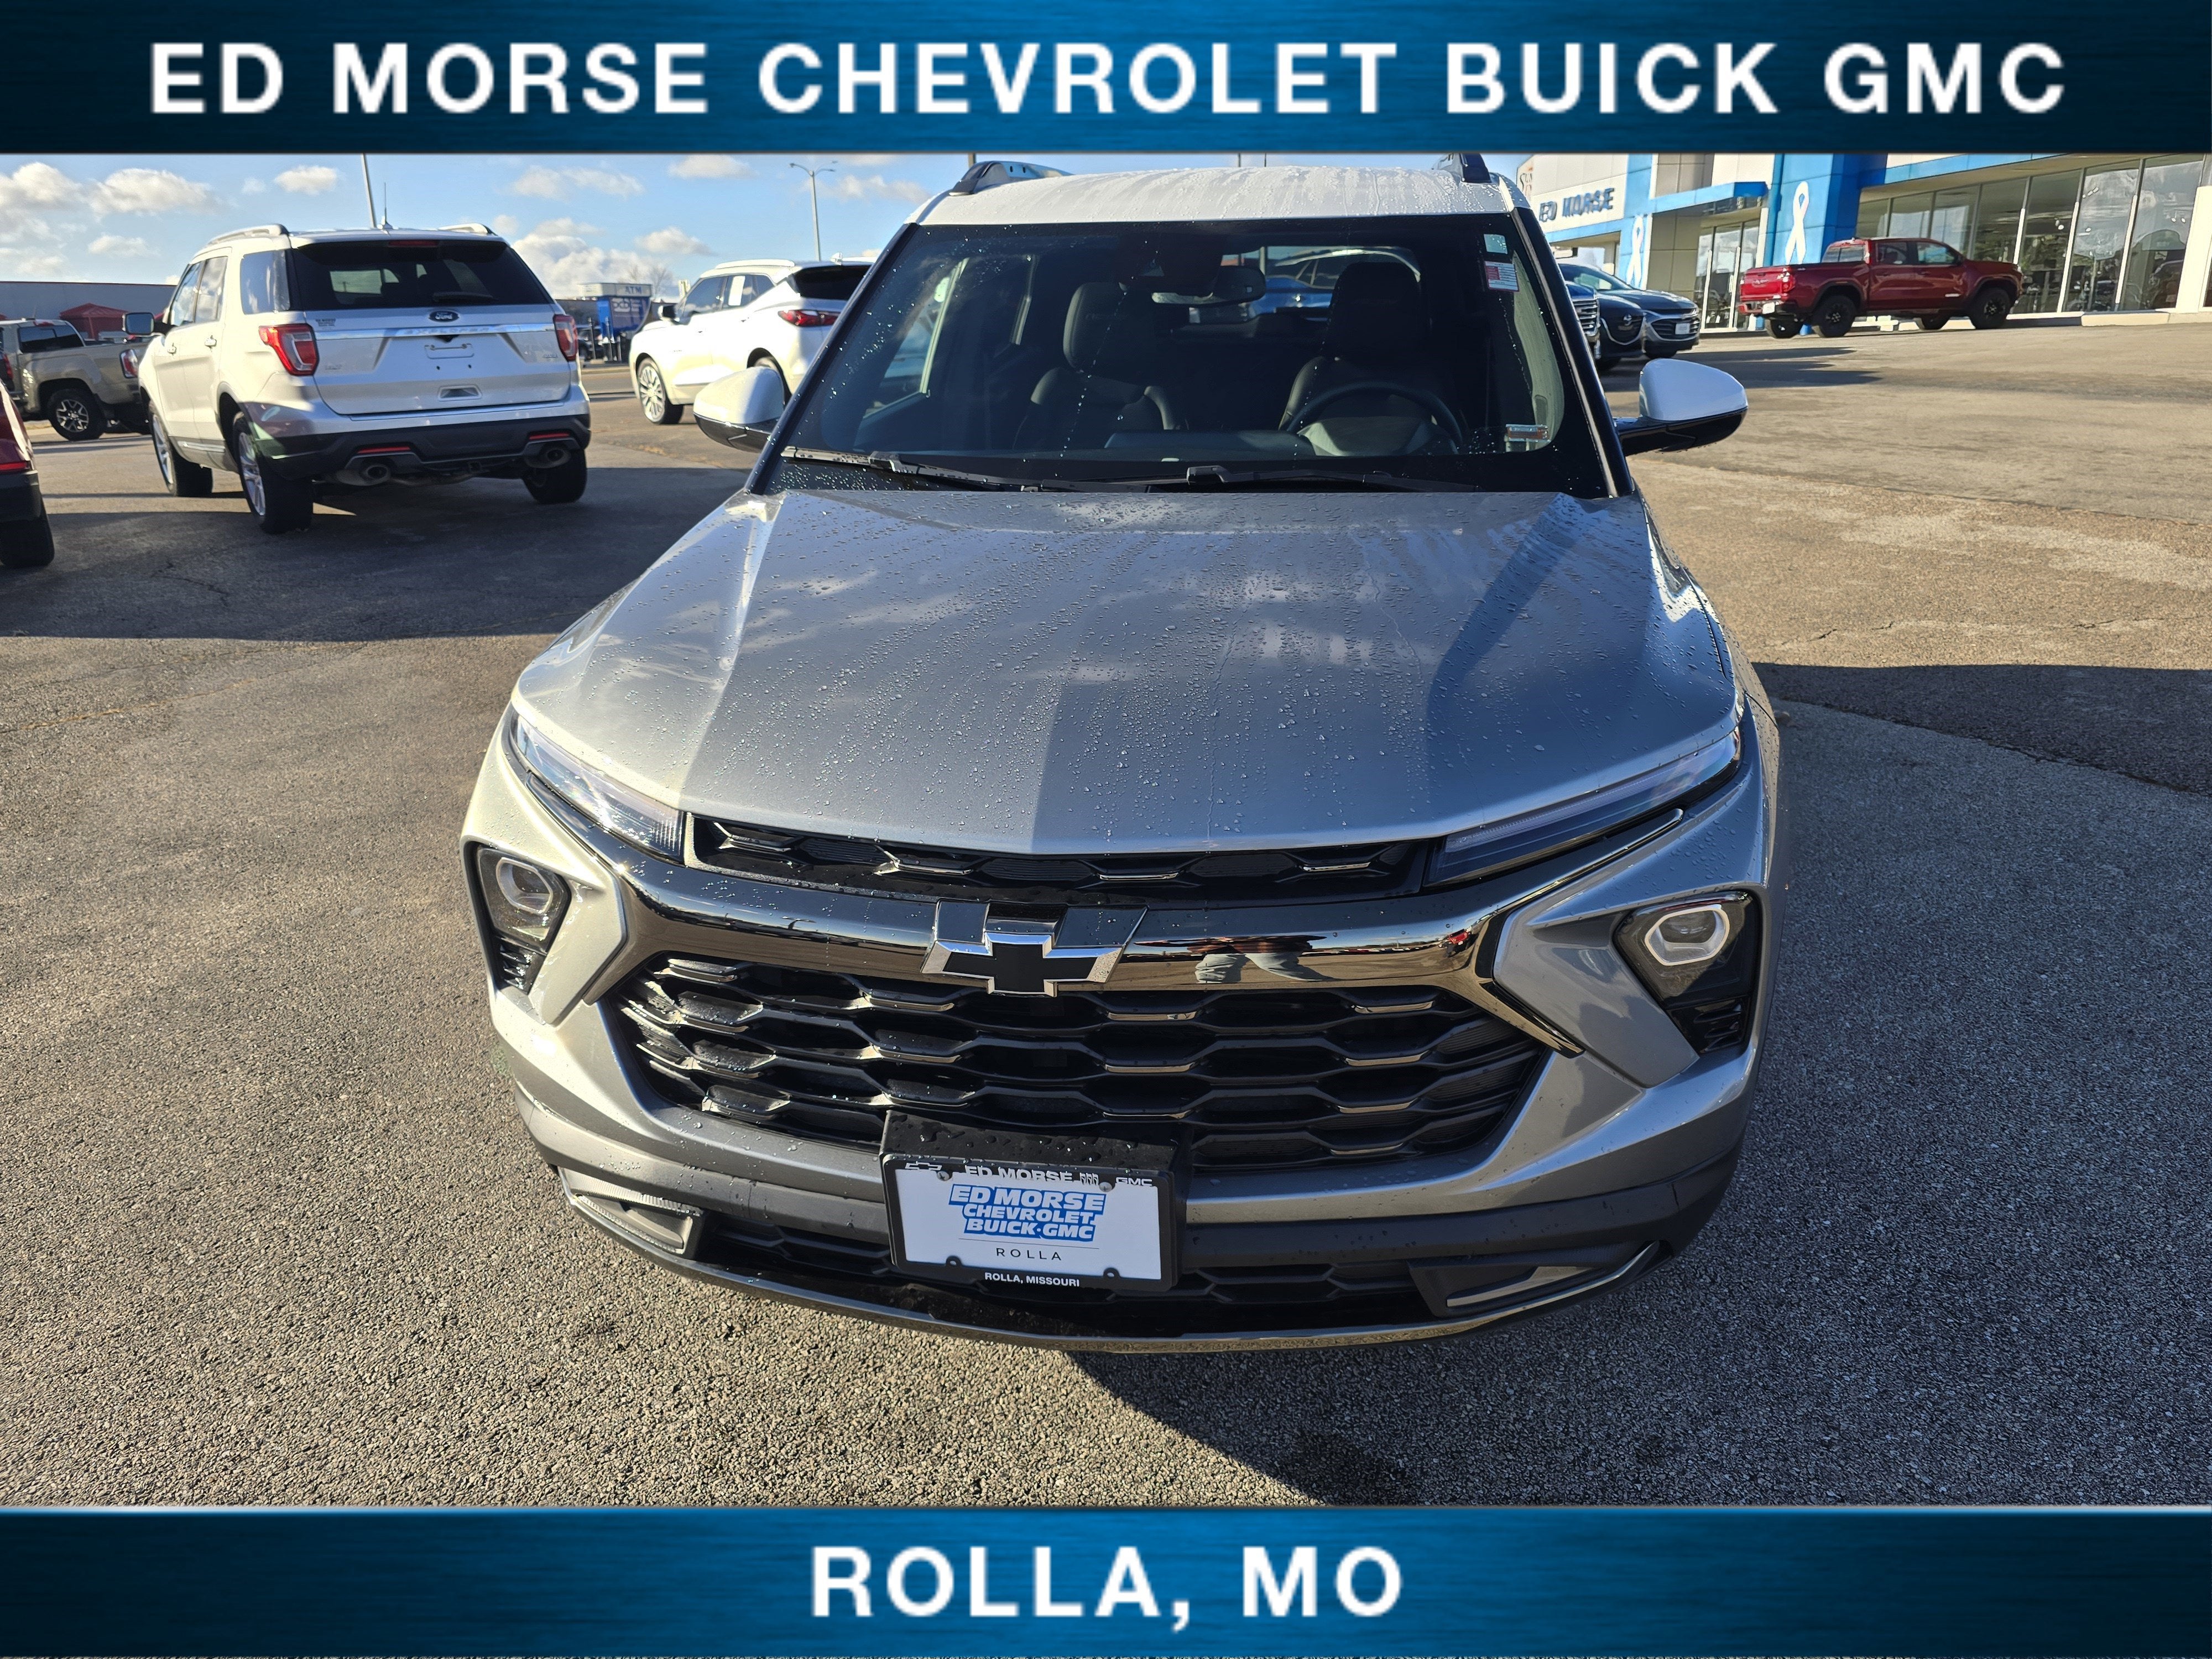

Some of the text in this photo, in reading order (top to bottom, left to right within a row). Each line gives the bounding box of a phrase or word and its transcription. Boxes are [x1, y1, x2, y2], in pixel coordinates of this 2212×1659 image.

[1538, 201, 1558, 222] ED
[1562, 187, 1615, 217] MORSE
[964, 1165, 1152, 1186] ED MORSE GMC
[950, 1185, 1105, 1212] ED MORSE
[995, 1248, 1062, 1261] ROLLA
[984, 1272, 1080, 1287] ROLLA, MISSOURI
